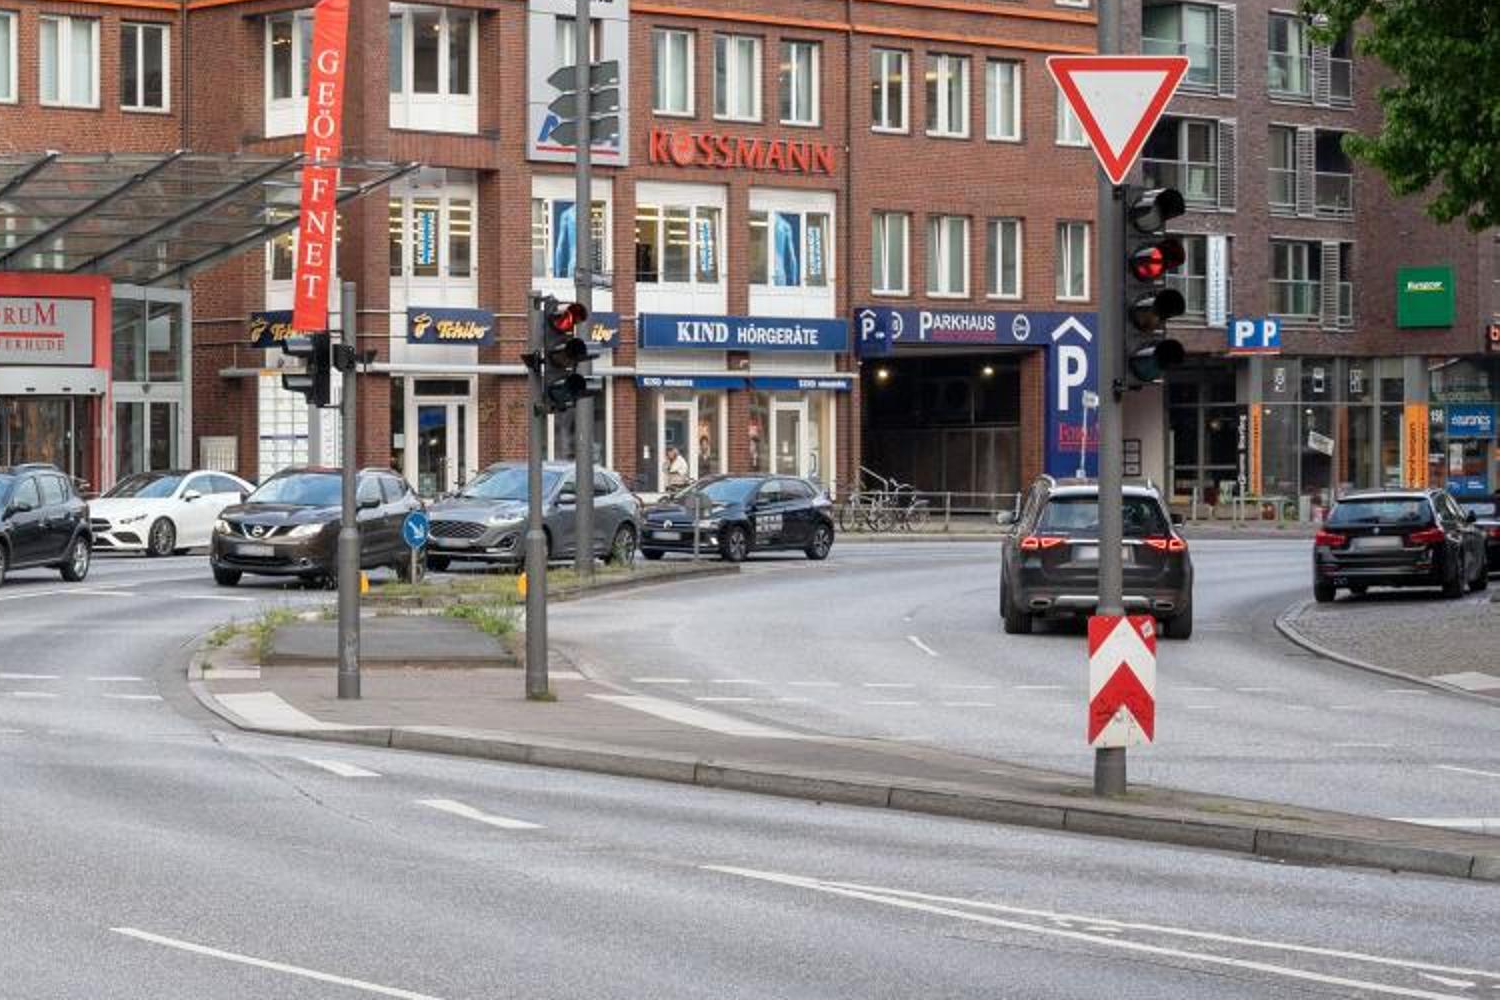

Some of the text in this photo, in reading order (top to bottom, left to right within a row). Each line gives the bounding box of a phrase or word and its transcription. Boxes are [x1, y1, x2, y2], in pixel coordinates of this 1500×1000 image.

[650, 128, 837, 176] ROSSMANN
[301, 49, 340, 299] GEÖFFNET
[436, 320, 490, 339] Tchibo
[676, 321, 819, 345] KIND HÖRGERÄTE
[1235, 320, 1277, 347] P P
[1058, 345, 1088, 411] P
